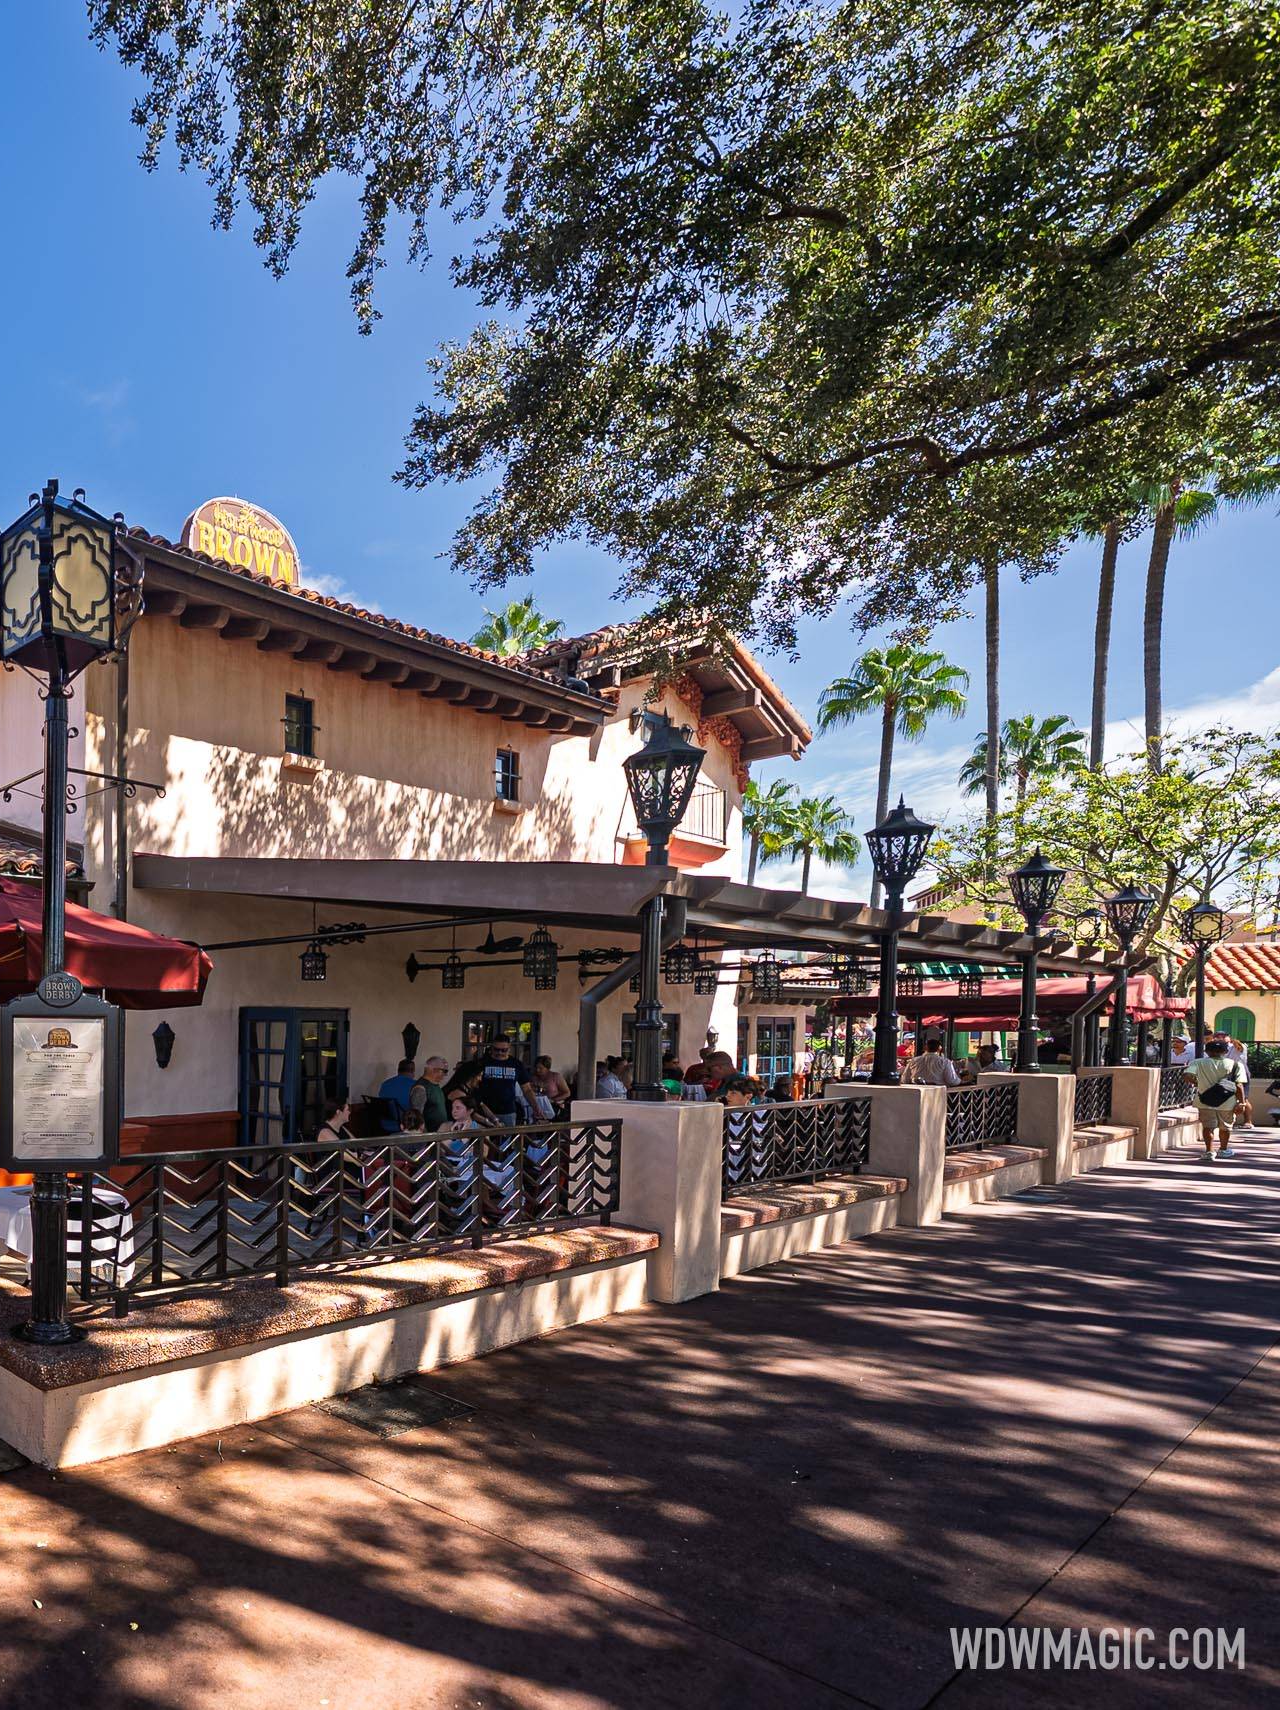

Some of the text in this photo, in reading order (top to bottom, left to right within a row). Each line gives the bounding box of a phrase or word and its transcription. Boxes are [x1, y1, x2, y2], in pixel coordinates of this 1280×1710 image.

[197, 519, 295, 584] BROWN
[46, 982, 77, 991] BROWN
[46, 990, 76, 1000] DERBY
